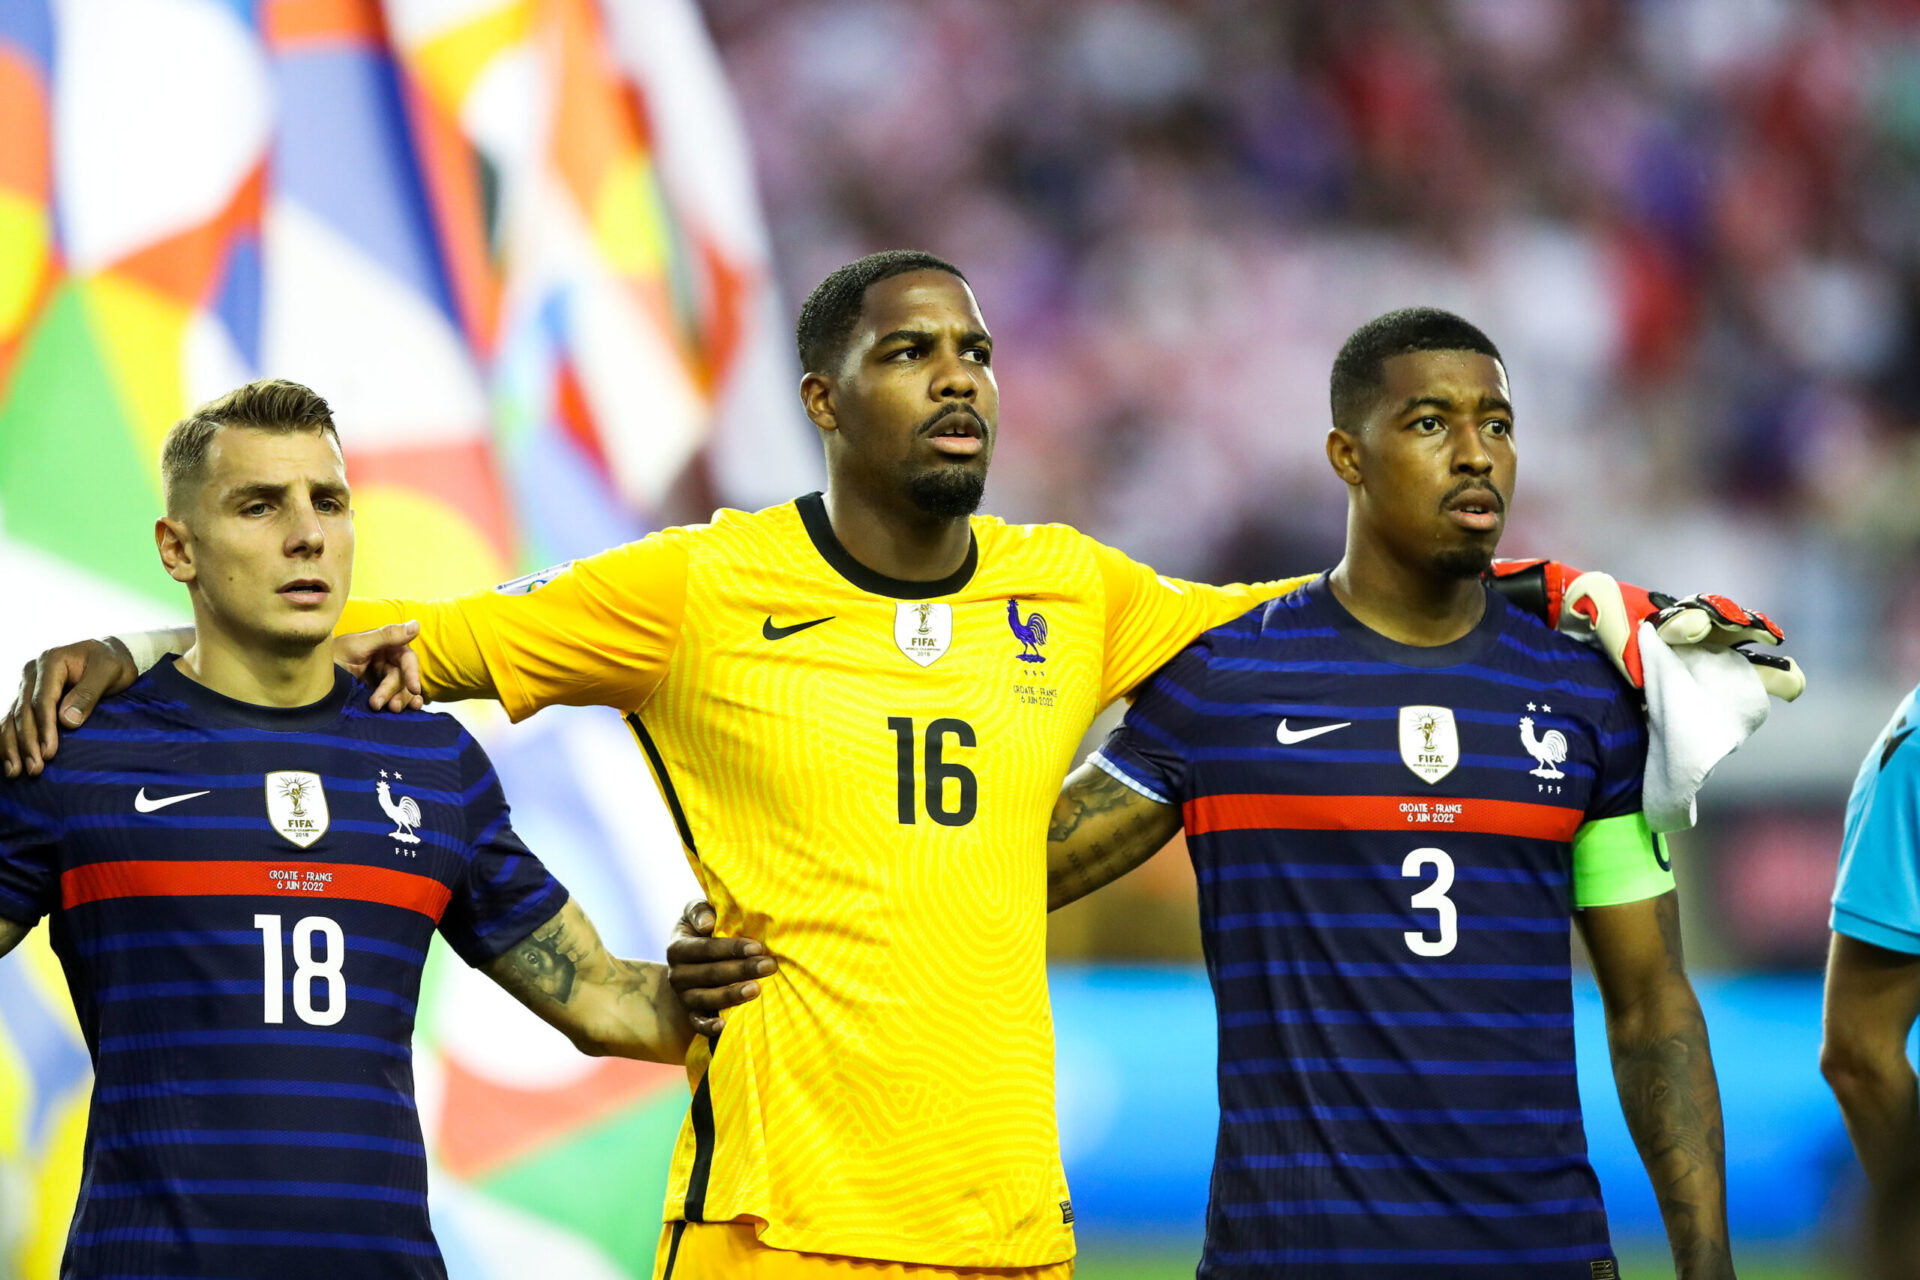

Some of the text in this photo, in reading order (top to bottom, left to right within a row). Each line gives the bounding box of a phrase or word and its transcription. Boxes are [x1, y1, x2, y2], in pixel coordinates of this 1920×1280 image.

[911, 637, 936, 647] FIFA
[1418, 754, 1443, 764] FIFA
[887, 716, 978, 827] 16
[1399, 803, 1428, 813] CROATIE
[1435, 804, 1463, 814] FRANCE
[1407, 813, 1455, 823] 6 JUIN 2022
[288, 820, 313, 828] FIFA
[269, 870, 299, 880] CROATIE
[306, 871, 333, 882] FRANCE
[276, 880, 324, 892] 6 JUIN 2022
[1402, 848, 1458, 957] 3
[254, 913, 346, 1026] 18
